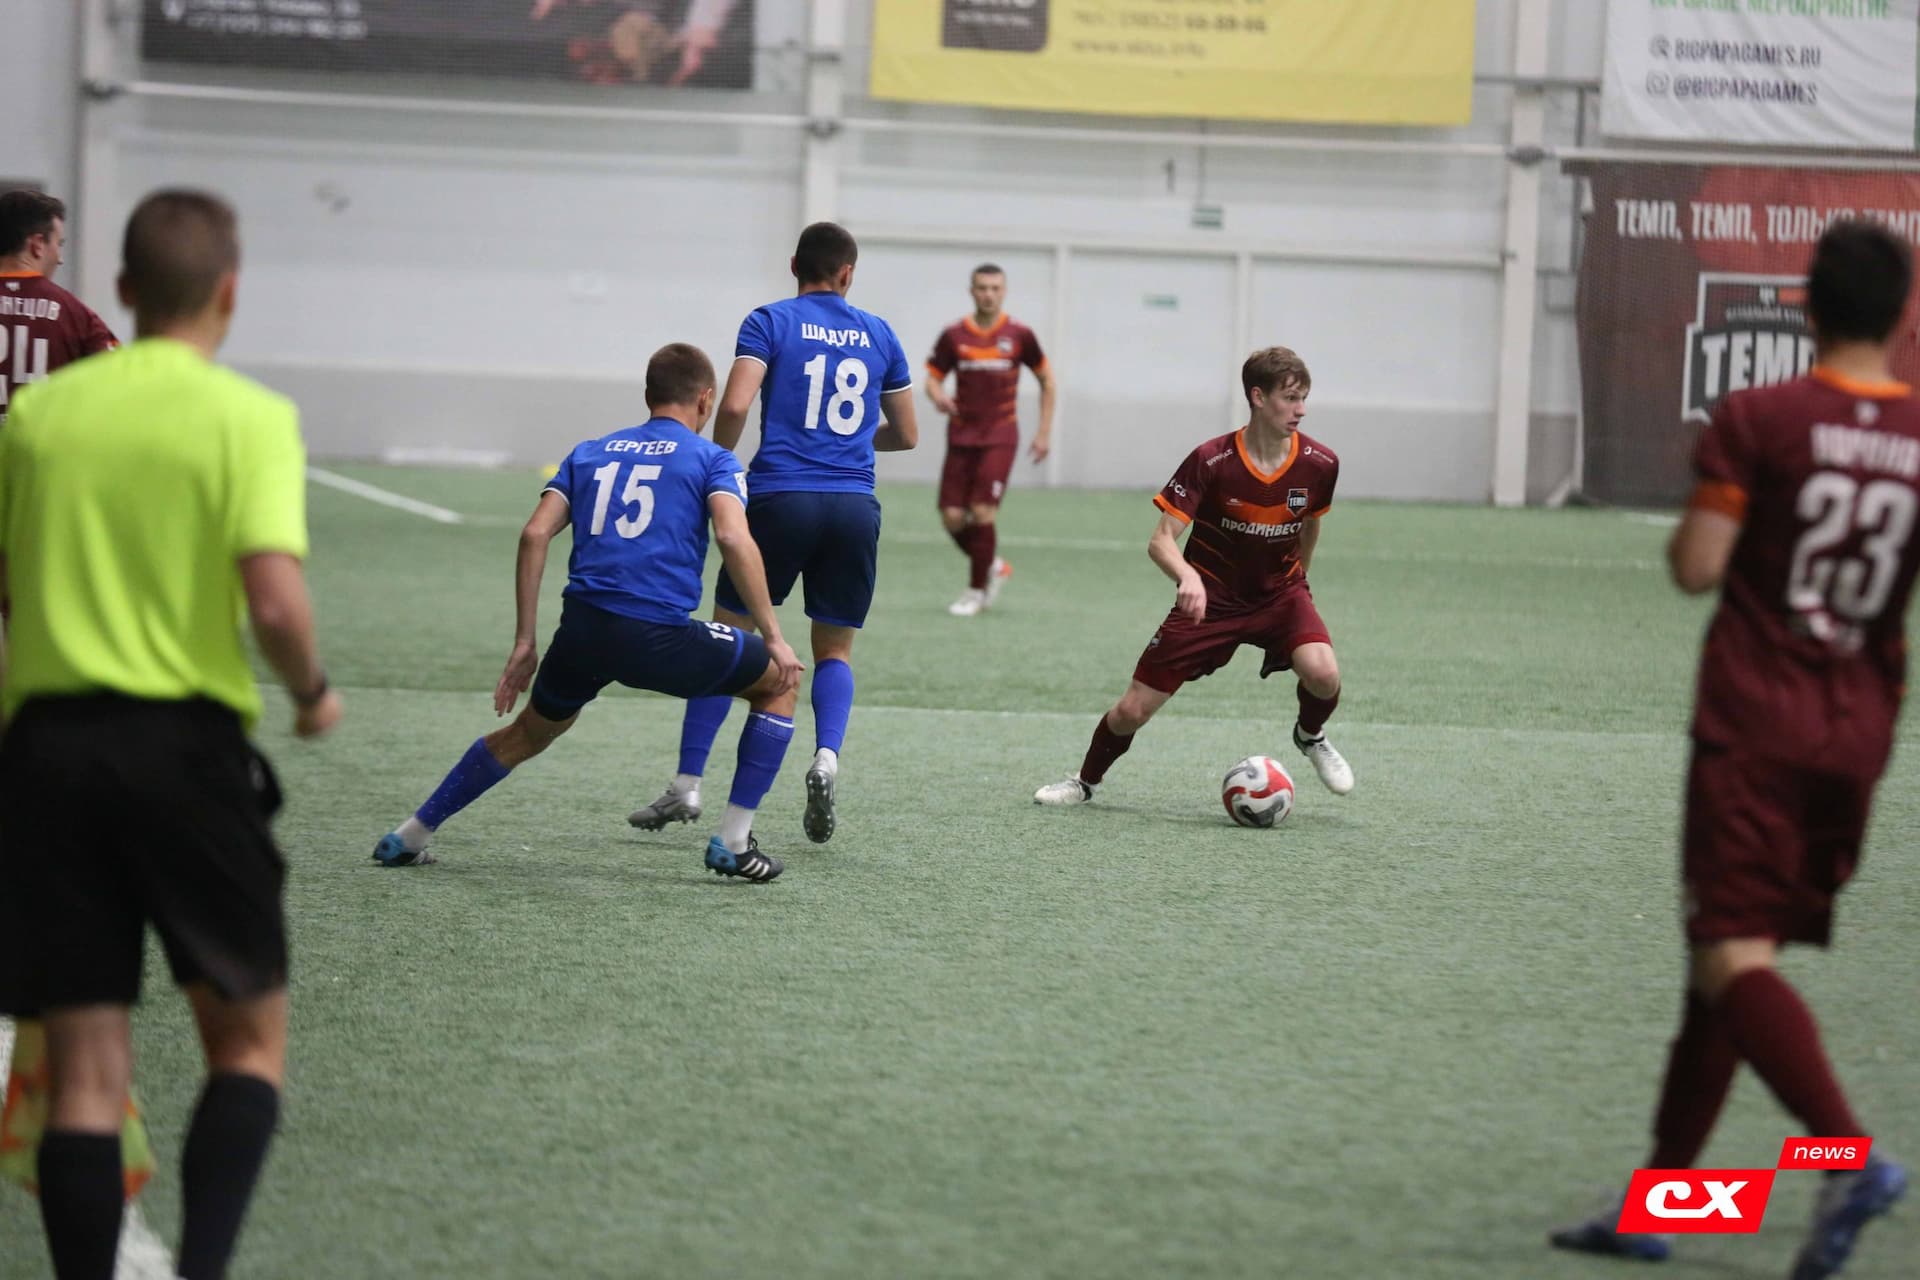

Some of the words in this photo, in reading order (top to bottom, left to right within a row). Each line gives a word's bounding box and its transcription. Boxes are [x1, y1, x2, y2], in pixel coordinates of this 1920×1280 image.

[1616, 199, 1682, 241] ТЕМП,
[1690, 202, 1757, 245] ТЕМП,
[0, 295, 61, 320] НЕЦОВ
[801, 322, 870, 349] ШАДУРА
[803, 354, 869, 436] 18
[604, 439, 678, 455] СЕРГЕЕВ
[590, 461, 662, 539] 15
[1221, 517, 1303, 538] ПРОДИНВЕСТ
[1788, 469, 1917, 622] 23
